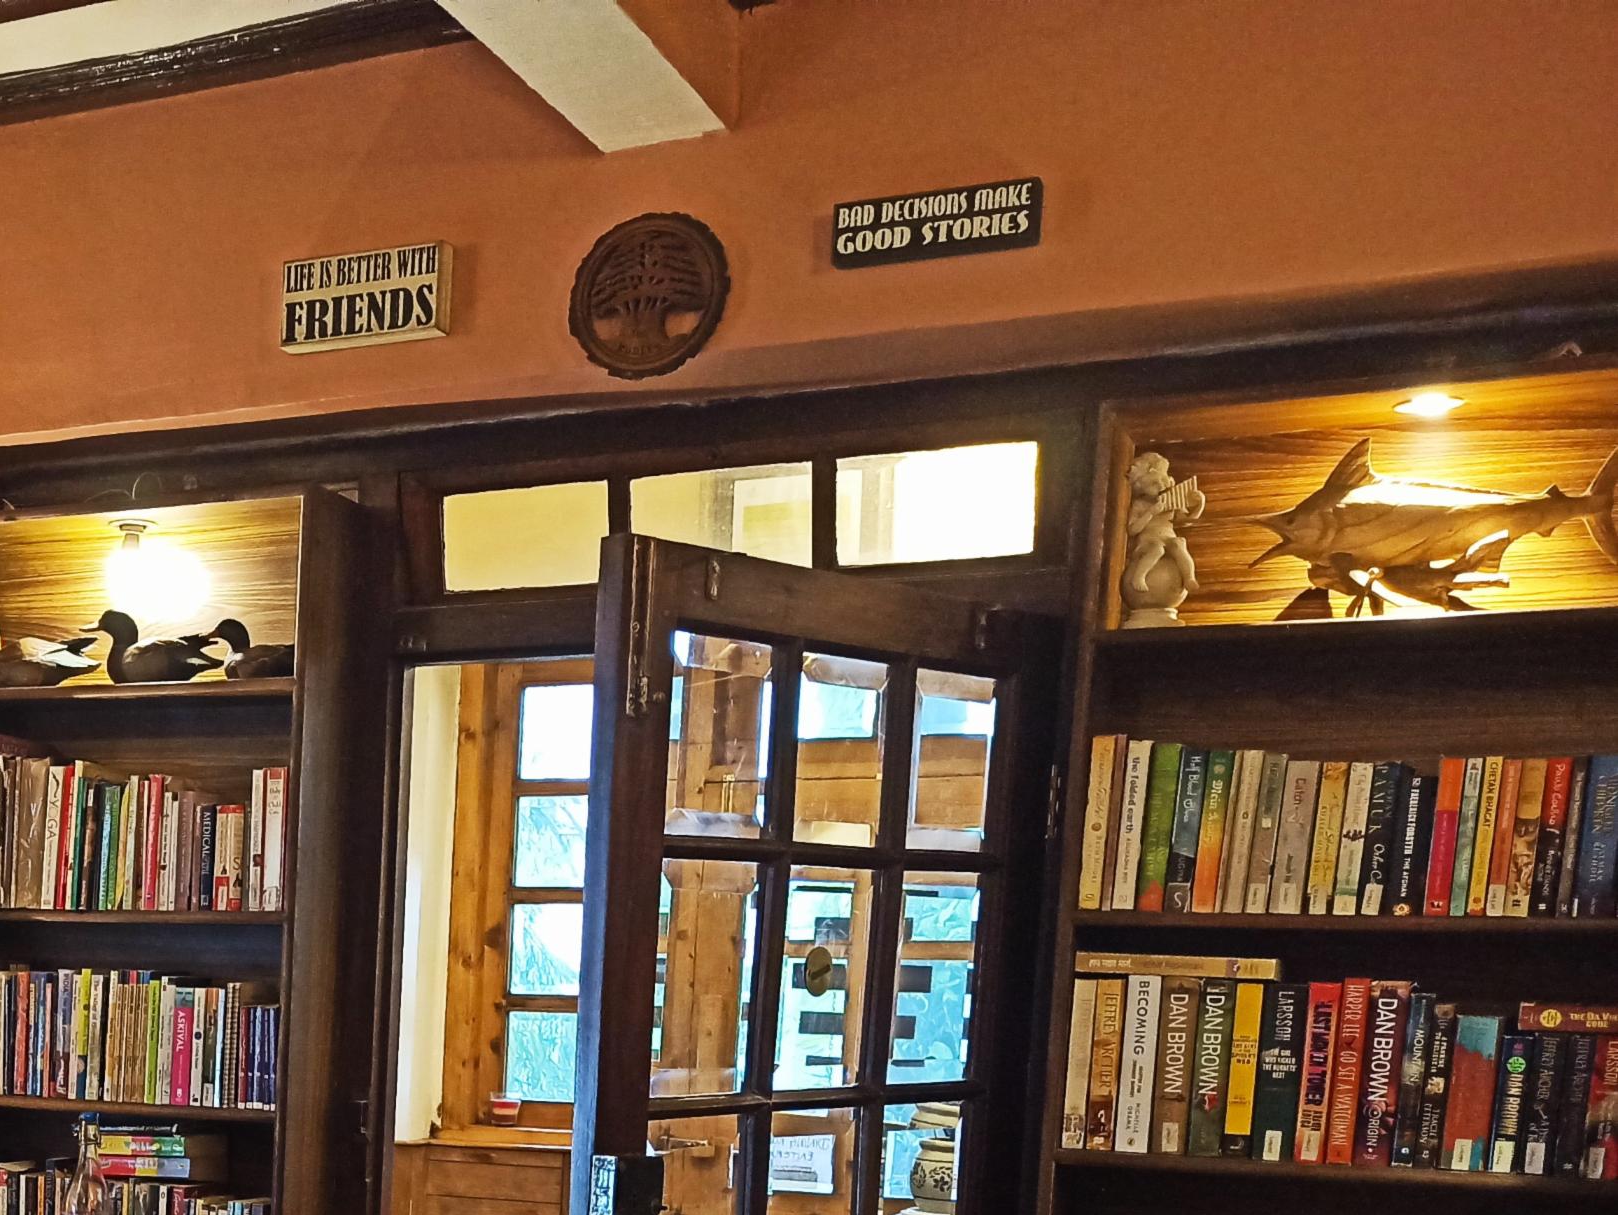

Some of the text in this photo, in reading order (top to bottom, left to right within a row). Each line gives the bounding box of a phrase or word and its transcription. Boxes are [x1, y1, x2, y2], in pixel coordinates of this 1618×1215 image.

[838, 183, 1032, 229] BAD DECISIONS MAKE
[836, 210, 1030, 255] GOOD STORIES
[285, 245, 437, 294] LIFE IS BETTER WITH
[283, 283, 434, 343] FRIENDS
[1125, 757, 1140, 833] the folded earth
[1186, 775, 1199, 795] Blood
[1368, 766, 1390, 834] PAMUK
[1482, 762, 1499, 828] CHETAN BHAGAT
[202, 812, 211, 855] MEDICAL
[1404, 789, 1420, 854] FREDERICK FORSYTH
[1399, 858, 1411, 897] THE AFGHAN
[176, 1011, 185, 1052] ASKIVAL
[1132, 981, 1151, 1056] BECOMING
[1274, 991, 1295, 1041] LARSSON
[1342, 985, 1365, 1038] HARPER LEE
[1162, 994, 1189, 1094] DAN BROWN
[1197, 995, 1226, 1095] DAN BROWN
[1340, 1051, 1359, 1063] GO
[1367, 998, 1399, 1101] DAN BROWN
[1338, 1067, 1356, 1080] SET
[1331, 1093, 1353, 1145] WATCHMAN
[1365, 1107, 1382, 1147] ORIGIN
